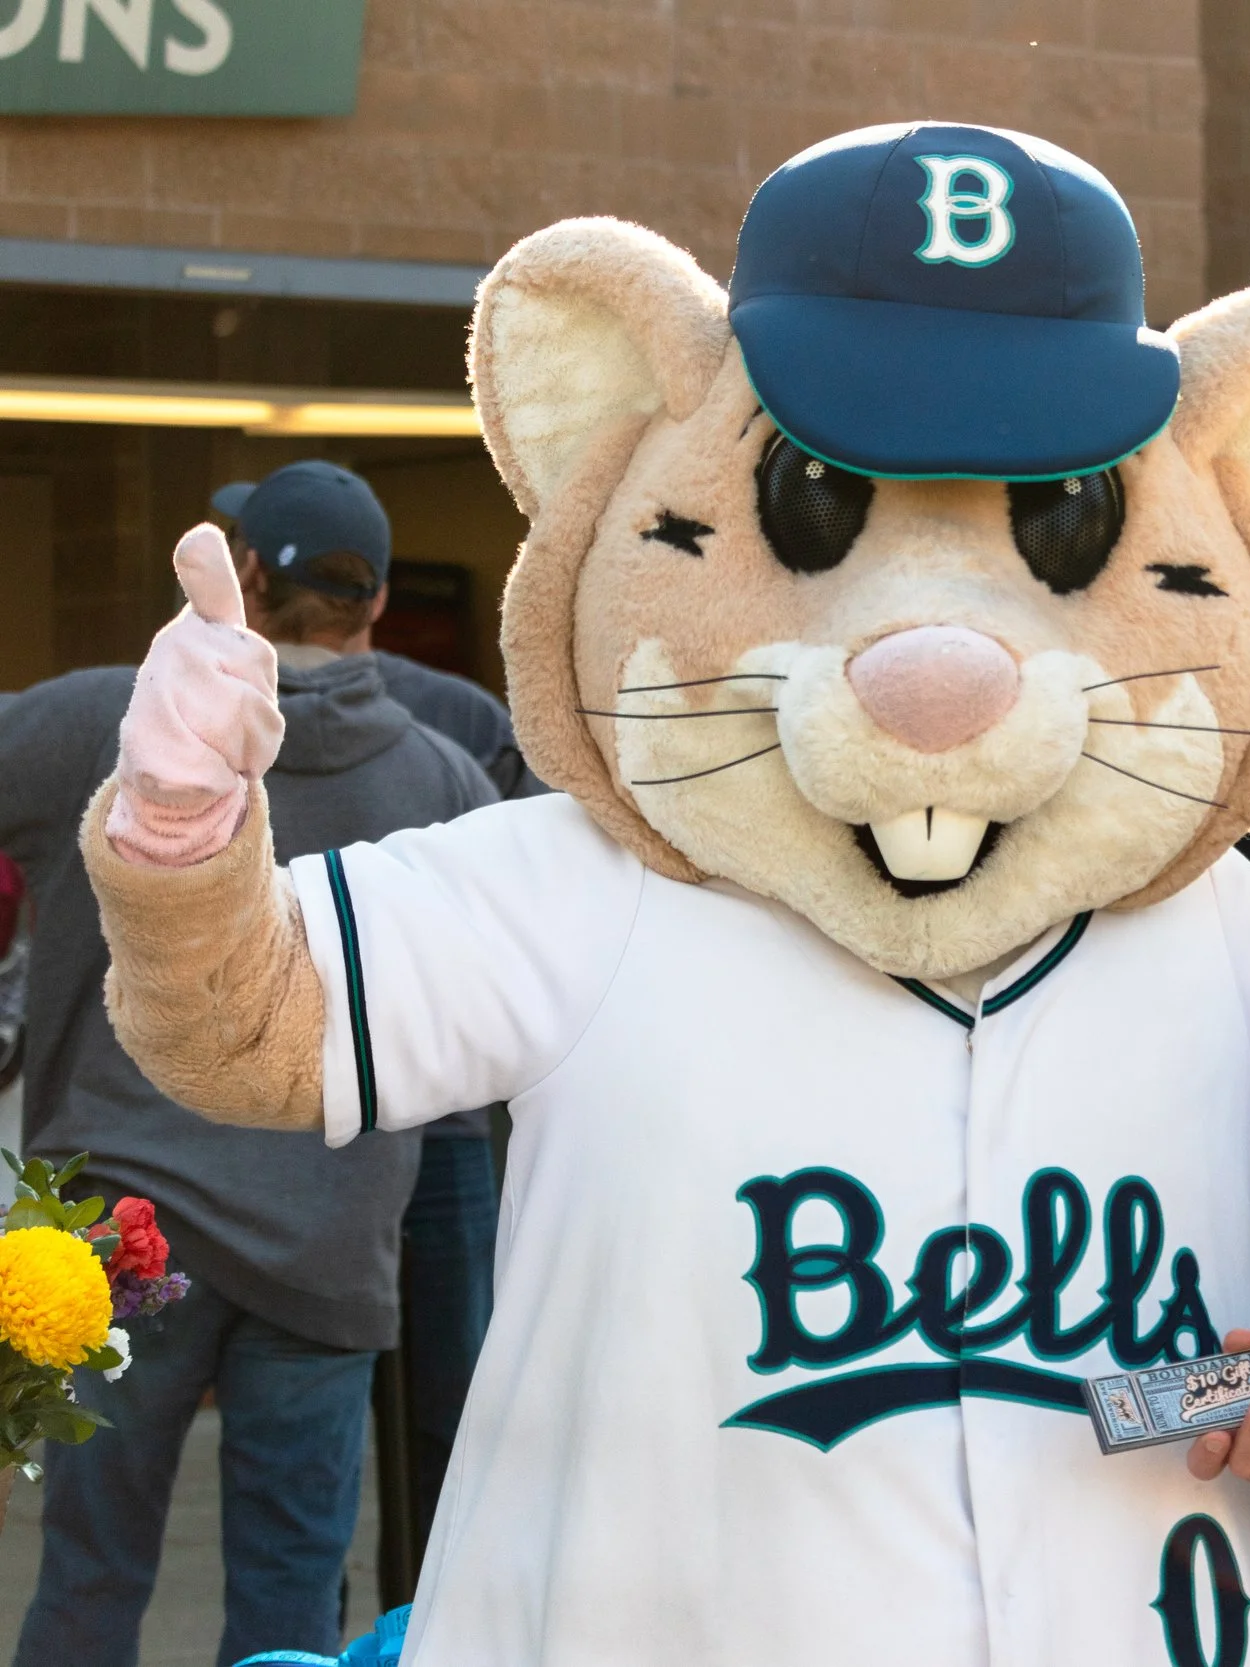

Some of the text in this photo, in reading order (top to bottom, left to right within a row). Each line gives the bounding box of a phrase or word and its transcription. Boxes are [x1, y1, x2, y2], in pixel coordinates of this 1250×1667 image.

[0, 0, 233, 76] NS
[913, 153, 1016, 269] B
[736, 1166, 1222, 1375] Bells
[1147, 1354, 1242, 1382] BOUNDARY
[1185, 1371, 1219, 1392] $10
